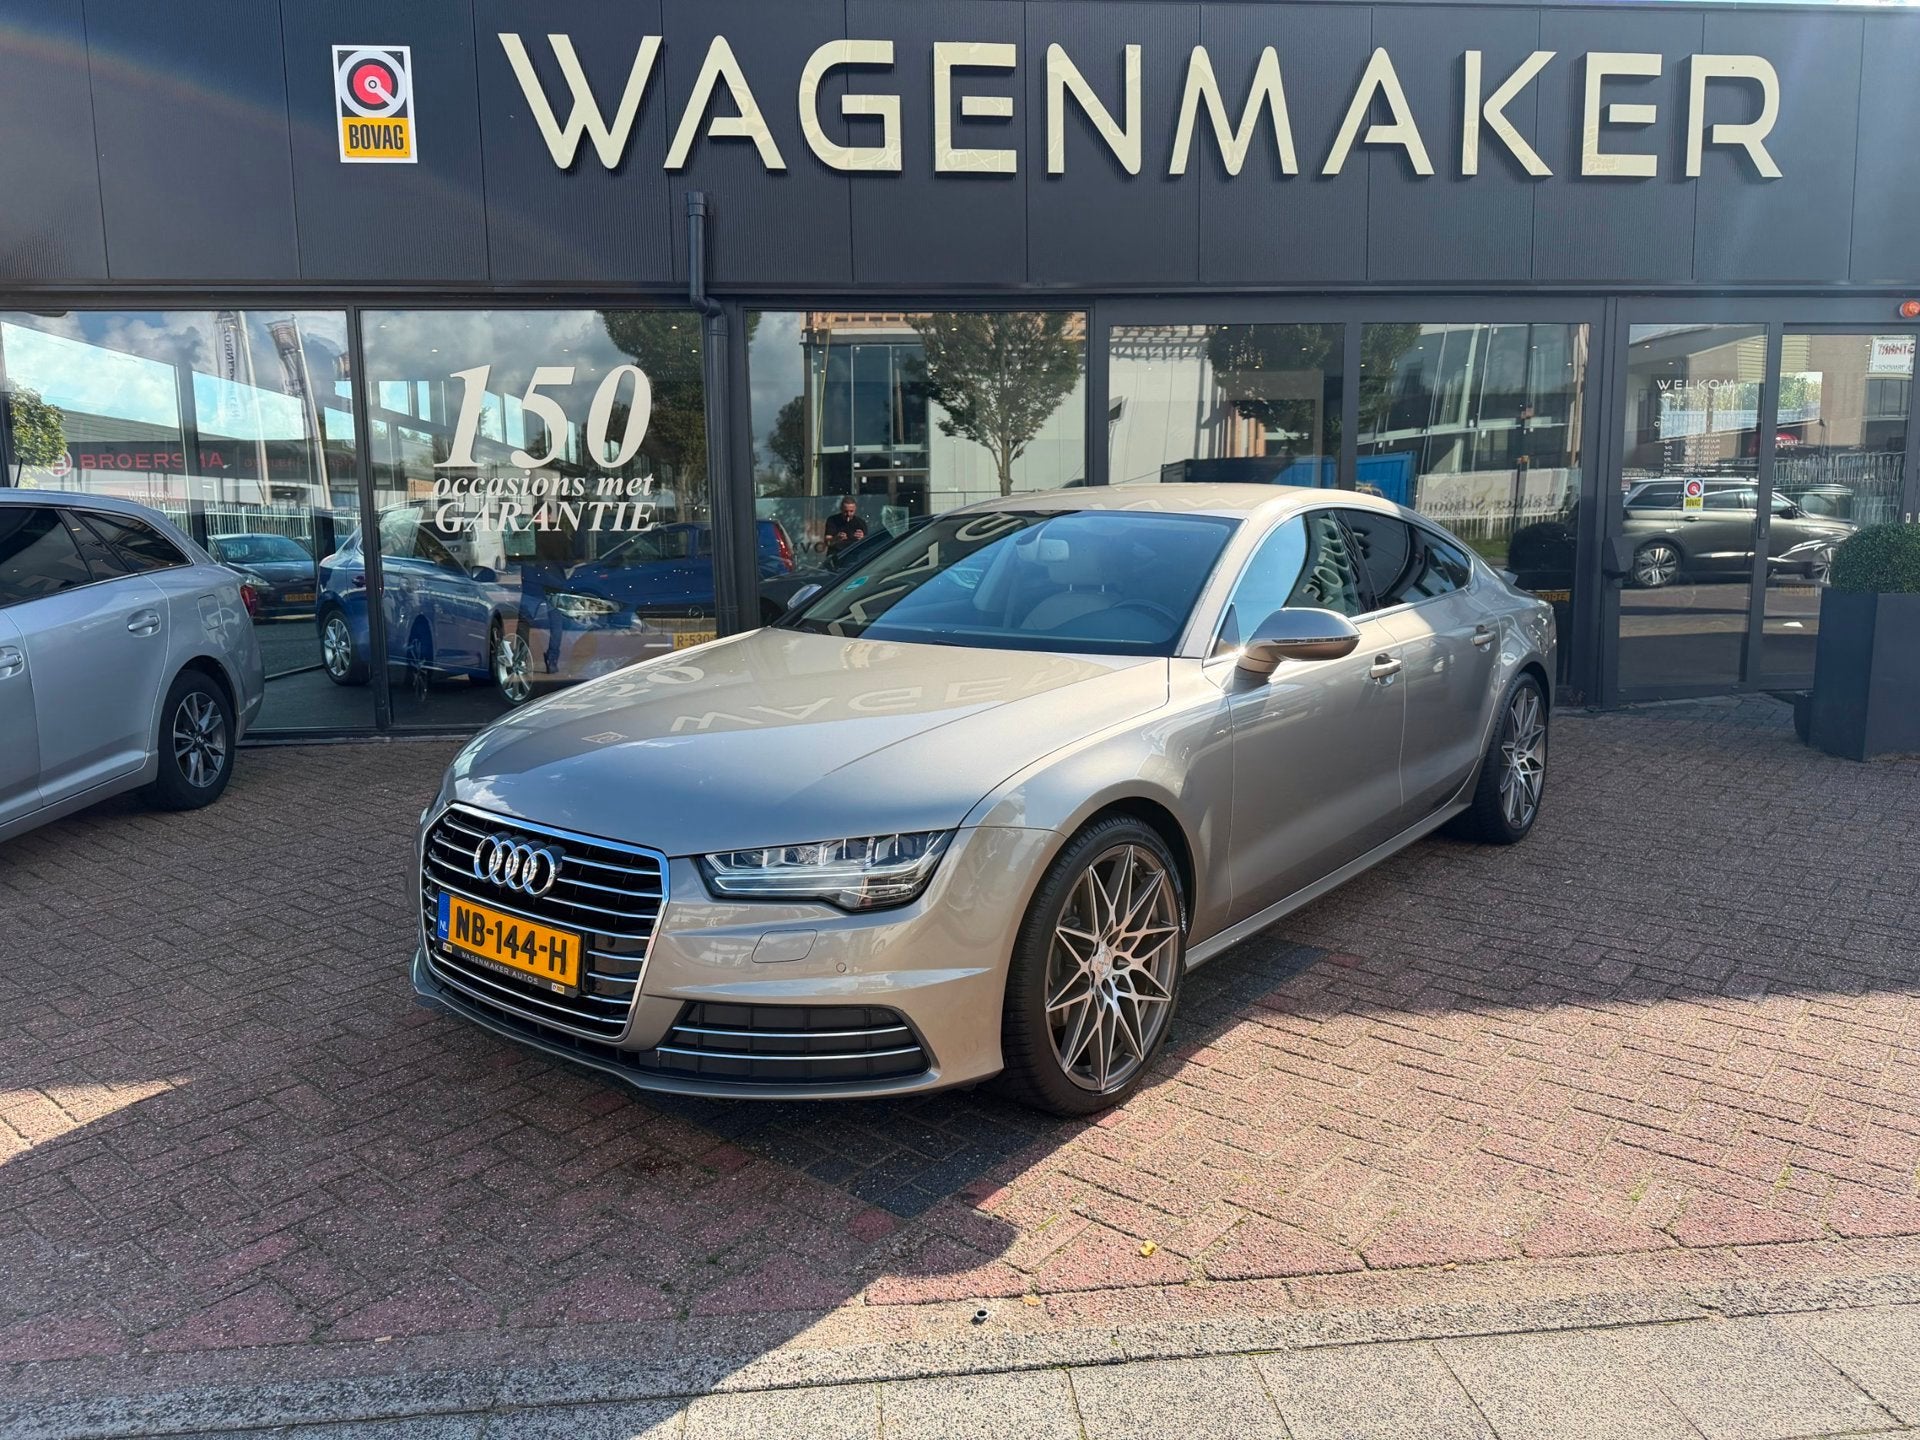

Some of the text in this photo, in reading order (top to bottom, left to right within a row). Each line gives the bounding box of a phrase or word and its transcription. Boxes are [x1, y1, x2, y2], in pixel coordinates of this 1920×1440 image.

[498, 32, 1783, 180] WAGENMAKER
[348, 123, 405, 150] BOVAG
[1657, 379, 1736, 391] WELKOM
[433, 364, 652, 469] 150
[432, 469, 654, 498] occasions met
[435, 501, 657, 534] GARANTIE
[439, 920, 448, 932] NL
[456, 905, 568, 975] NB-144-H
[461, 952, 539, 985] WAGENMAKER AUTOS
